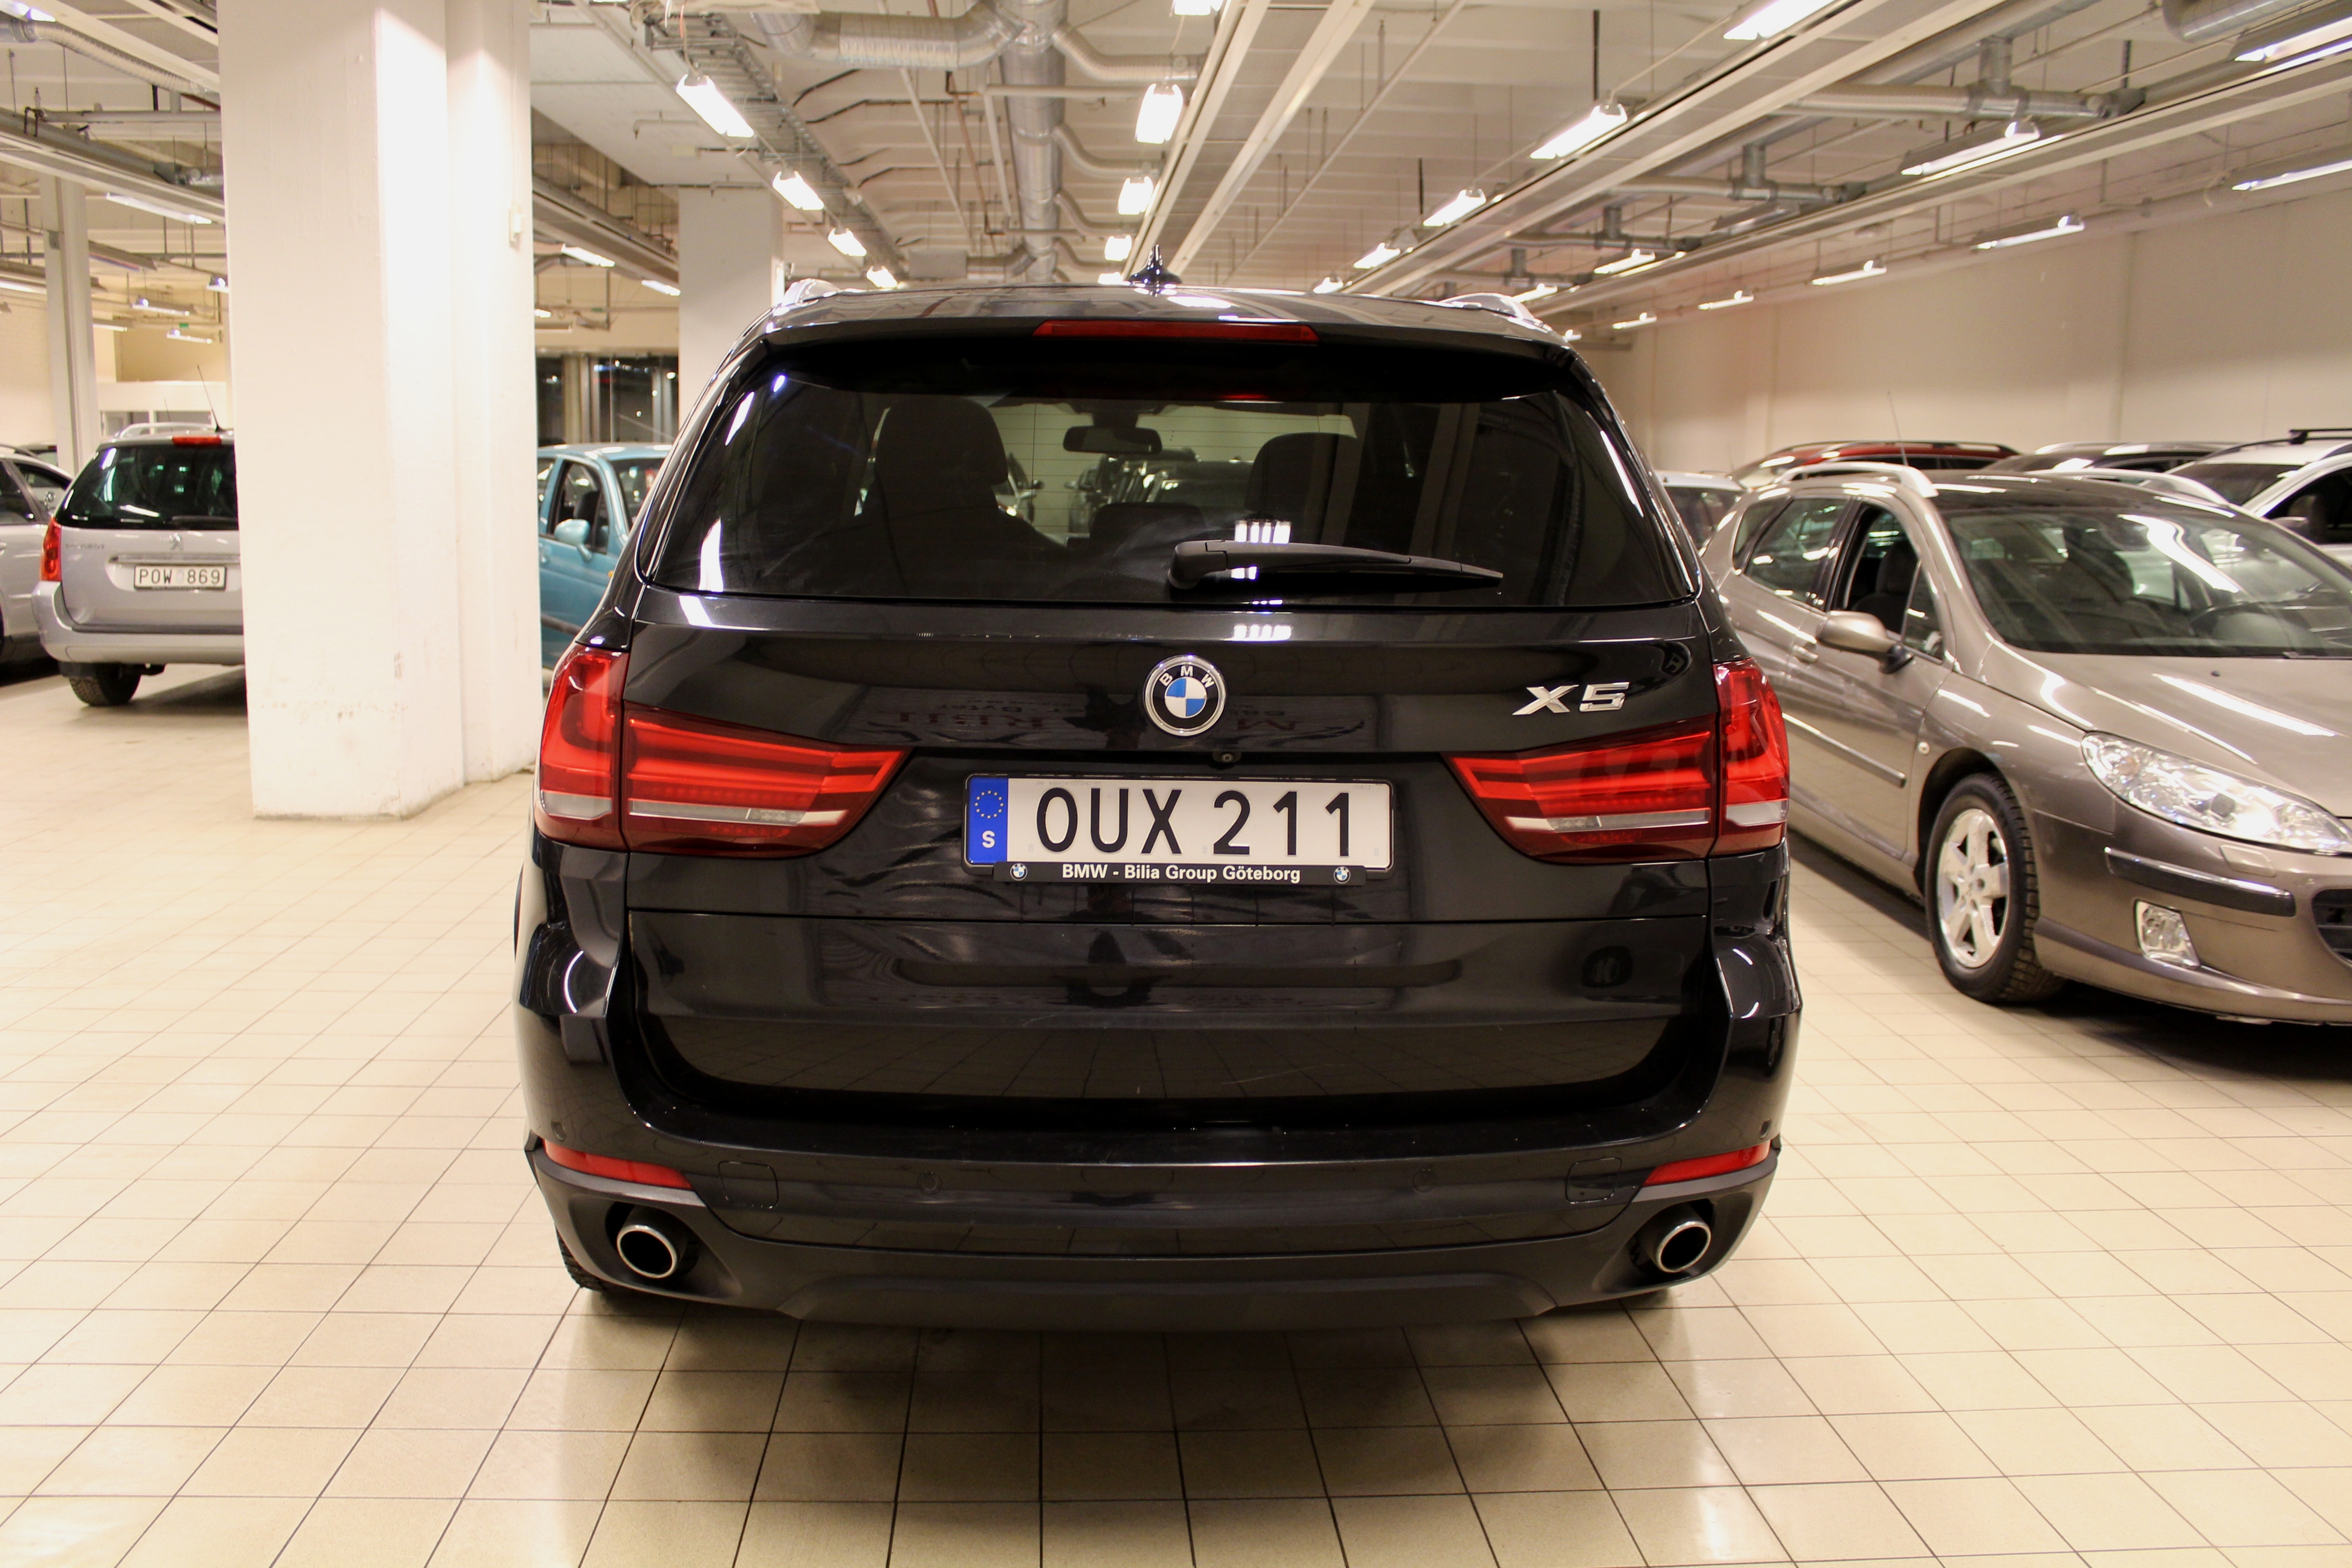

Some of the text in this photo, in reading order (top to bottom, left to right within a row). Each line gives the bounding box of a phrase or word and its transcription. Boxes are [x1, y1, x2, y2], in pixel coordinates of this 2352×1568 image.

[139, 569, 220, 584] POW 869
[1159, 666, 1215, 688] BMW
[1512, 681, 1630, 715] X5
[1036, 788, 1349, 857] OUX 211
[982, 830, 995, 848] S
[1063, 864, 1108, 878] BMW
[1124, 864, 1160, 879] Bilia
[1166, 865, 1217, 883] Group
[1222, 866, 1301, 884] Göteborg
